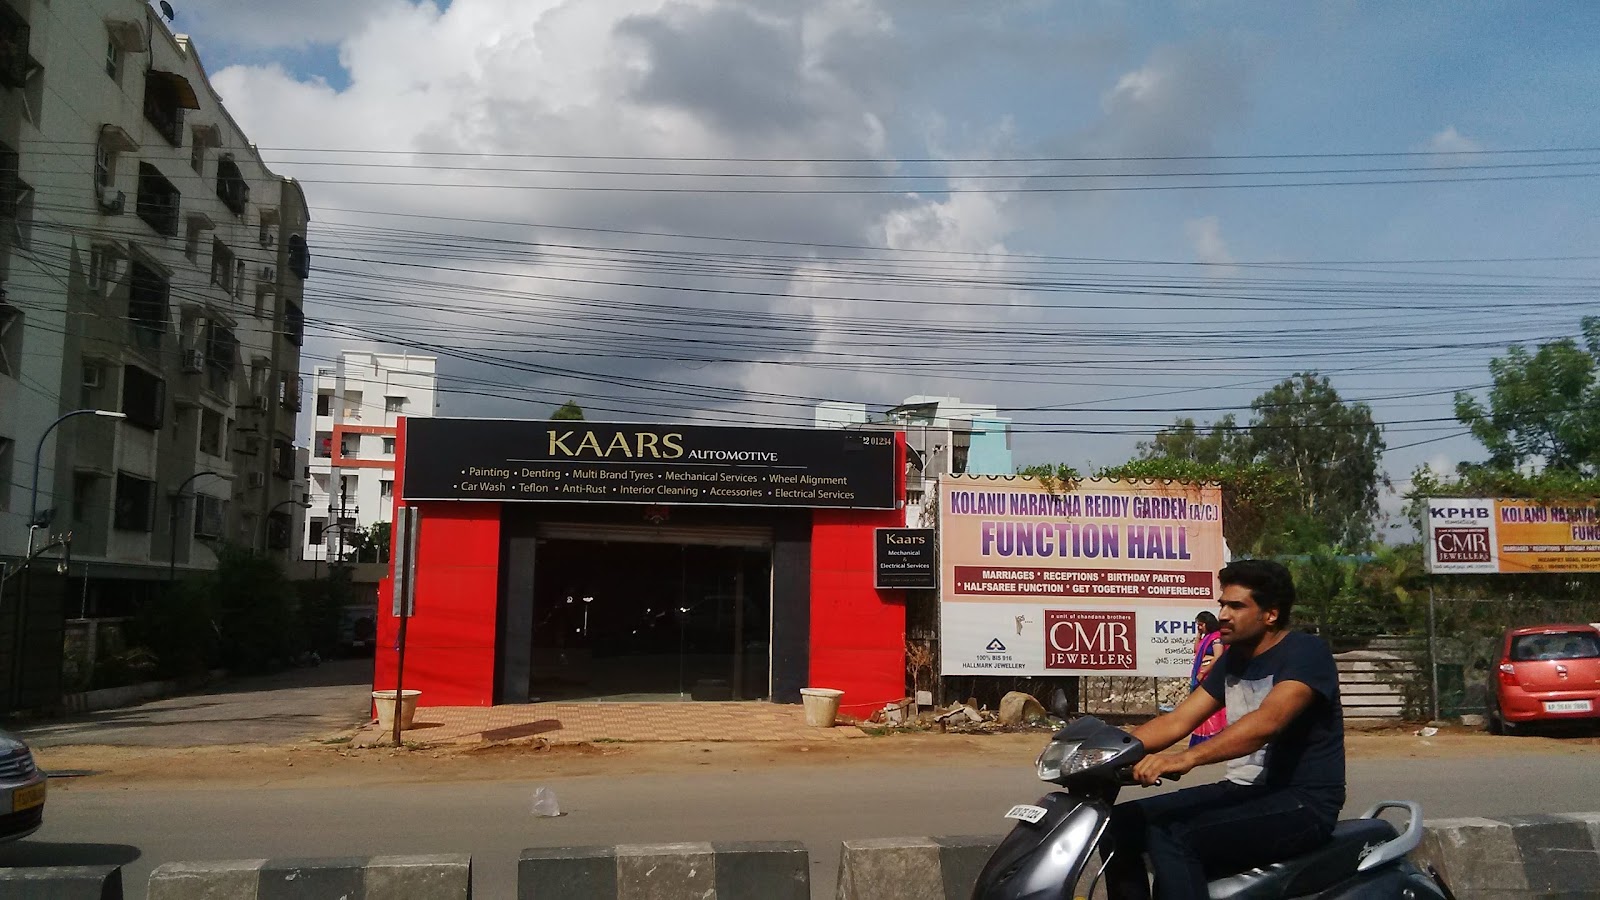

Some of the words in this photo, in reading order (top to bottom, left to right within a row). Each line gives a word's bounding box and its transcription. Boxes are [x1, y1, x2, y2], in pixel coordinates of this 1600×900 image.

[547, 430, 684, 459] KAARS
[688, 449, 778, 462] AUTOMOTIVE
[469, 466, 510, 480] Painting
[521, 468, 561, 480] Denting
[572, 469, 598, 479] Multi
[600, 470, 628, 480] Brand
[630, 470, 654, 482] Tyres
[665, 471, 718, 481] Mechanical
[720, 472, 758, 483] Services
[769, 473, 798, 484] Wheel
[800, 474, 847, 487] Alignment
[461, 482, 478, 491] Car
[479, 482, 506, 492] Wash
[519, 482, 549, 493] Teflon
[562, 484, 607, 494] Anti-Rust
[620, 485, 655, 495] Interior
[656, 485, 699, 498] Cleaning
[709, 487, 763, 497] Accessories
[775, 488, 816, 499] Electrical
[818, 489, 855, 500] Services
[951, 491, 1006, 516] KOLANU
[1010, 493, 1082, 517] NARAYANA
[1084, 495, 1129, 519] REDDY
[1133, 496, 1187, 520] GARDEN
[1431, 507, 1490, 518] KPHB
[1501, 507, 1548, 523] KOLANU
[886, 533, 926, 545] Kaars
[982, 521, 1119, 559] FUNCTION
[1127, 525, 1191, 560] HALL
[1437, 533, 1488, 553] CMR
[1439, 553, 1489, 561] JEWELLERS
[982, 570, 1035, 580] MARRIAGES
[1043, 571, 1099, 581] RECEPTIONS
[1107, 572, 1151, 582] BIRTHDAY
[1153, 574, 1186, 583] PARTYS
[964, 582, 1017, 592] HALFSAREE
[1018, 583, 1064, 593] FUNCTION
[1072, 584, 1091, 594] GET
[1092, 584, 1140, 595] TOGETHER
[1147, 586, 1211, 596] CONFERENCES
[1154, 620, 1196, 634] KPH
[1049, 621, 1132, 652] CMR
[1049, 653, 1133, 669] JEWELLERS
